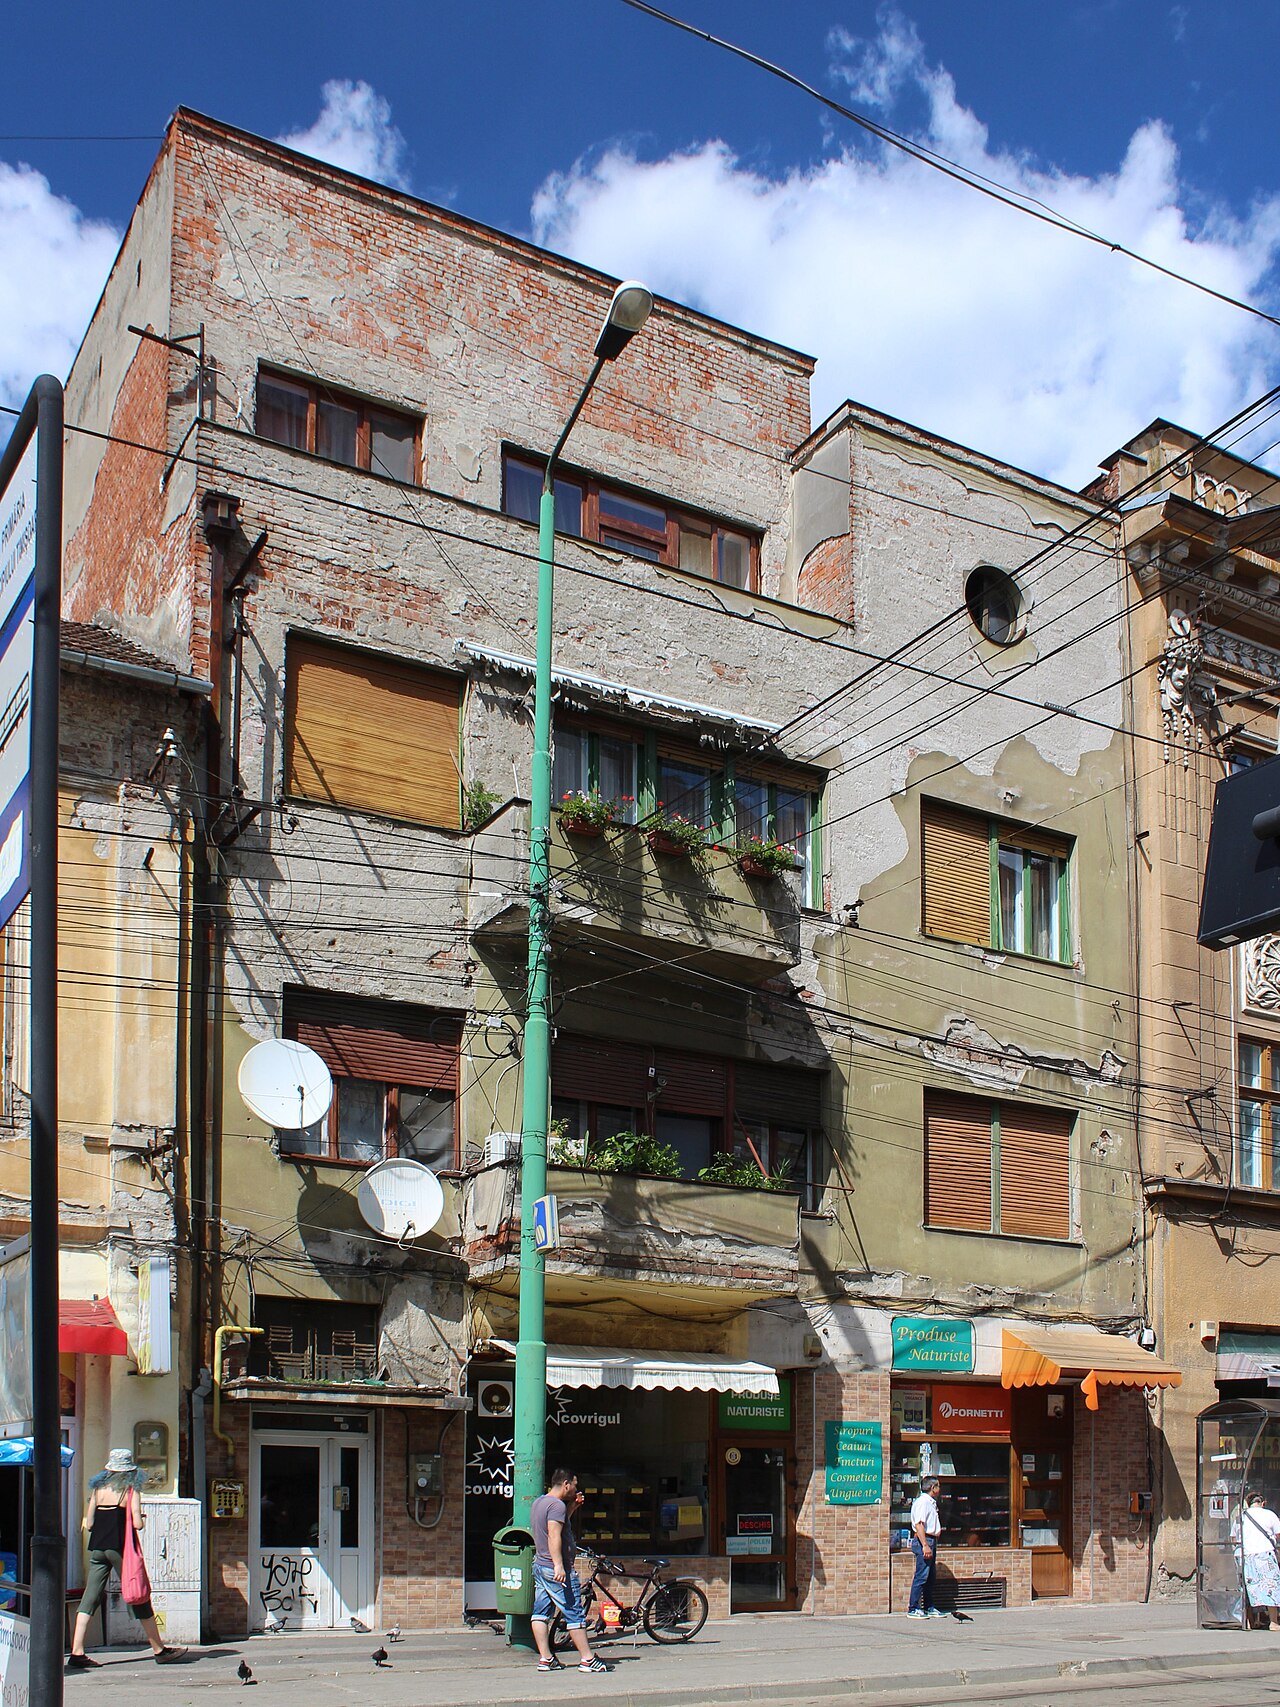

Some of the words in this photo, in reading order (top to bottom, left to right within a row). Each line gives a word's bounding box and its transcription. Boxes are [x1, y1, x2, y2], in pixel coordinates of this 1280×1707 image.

[896, 1325, 957, 1342] Produse
[908, 1348, 970, 1362] Naturiste
[727, 1406, 784, 1417] NATURISTE
[952, 1408, 1003, 1418] FORNETTI
[561, 1412, 621, 1427] covrigul
[834, 1426, 874, 1438] Siropuri
[836, 1441, 872, 1451] Ceaiuri
[835, 1457, 875, 1467] Tincturi
[830, 1472, 878, 1482] Cosmetice
[740, 1521, 771, 1529] DESCHIS
